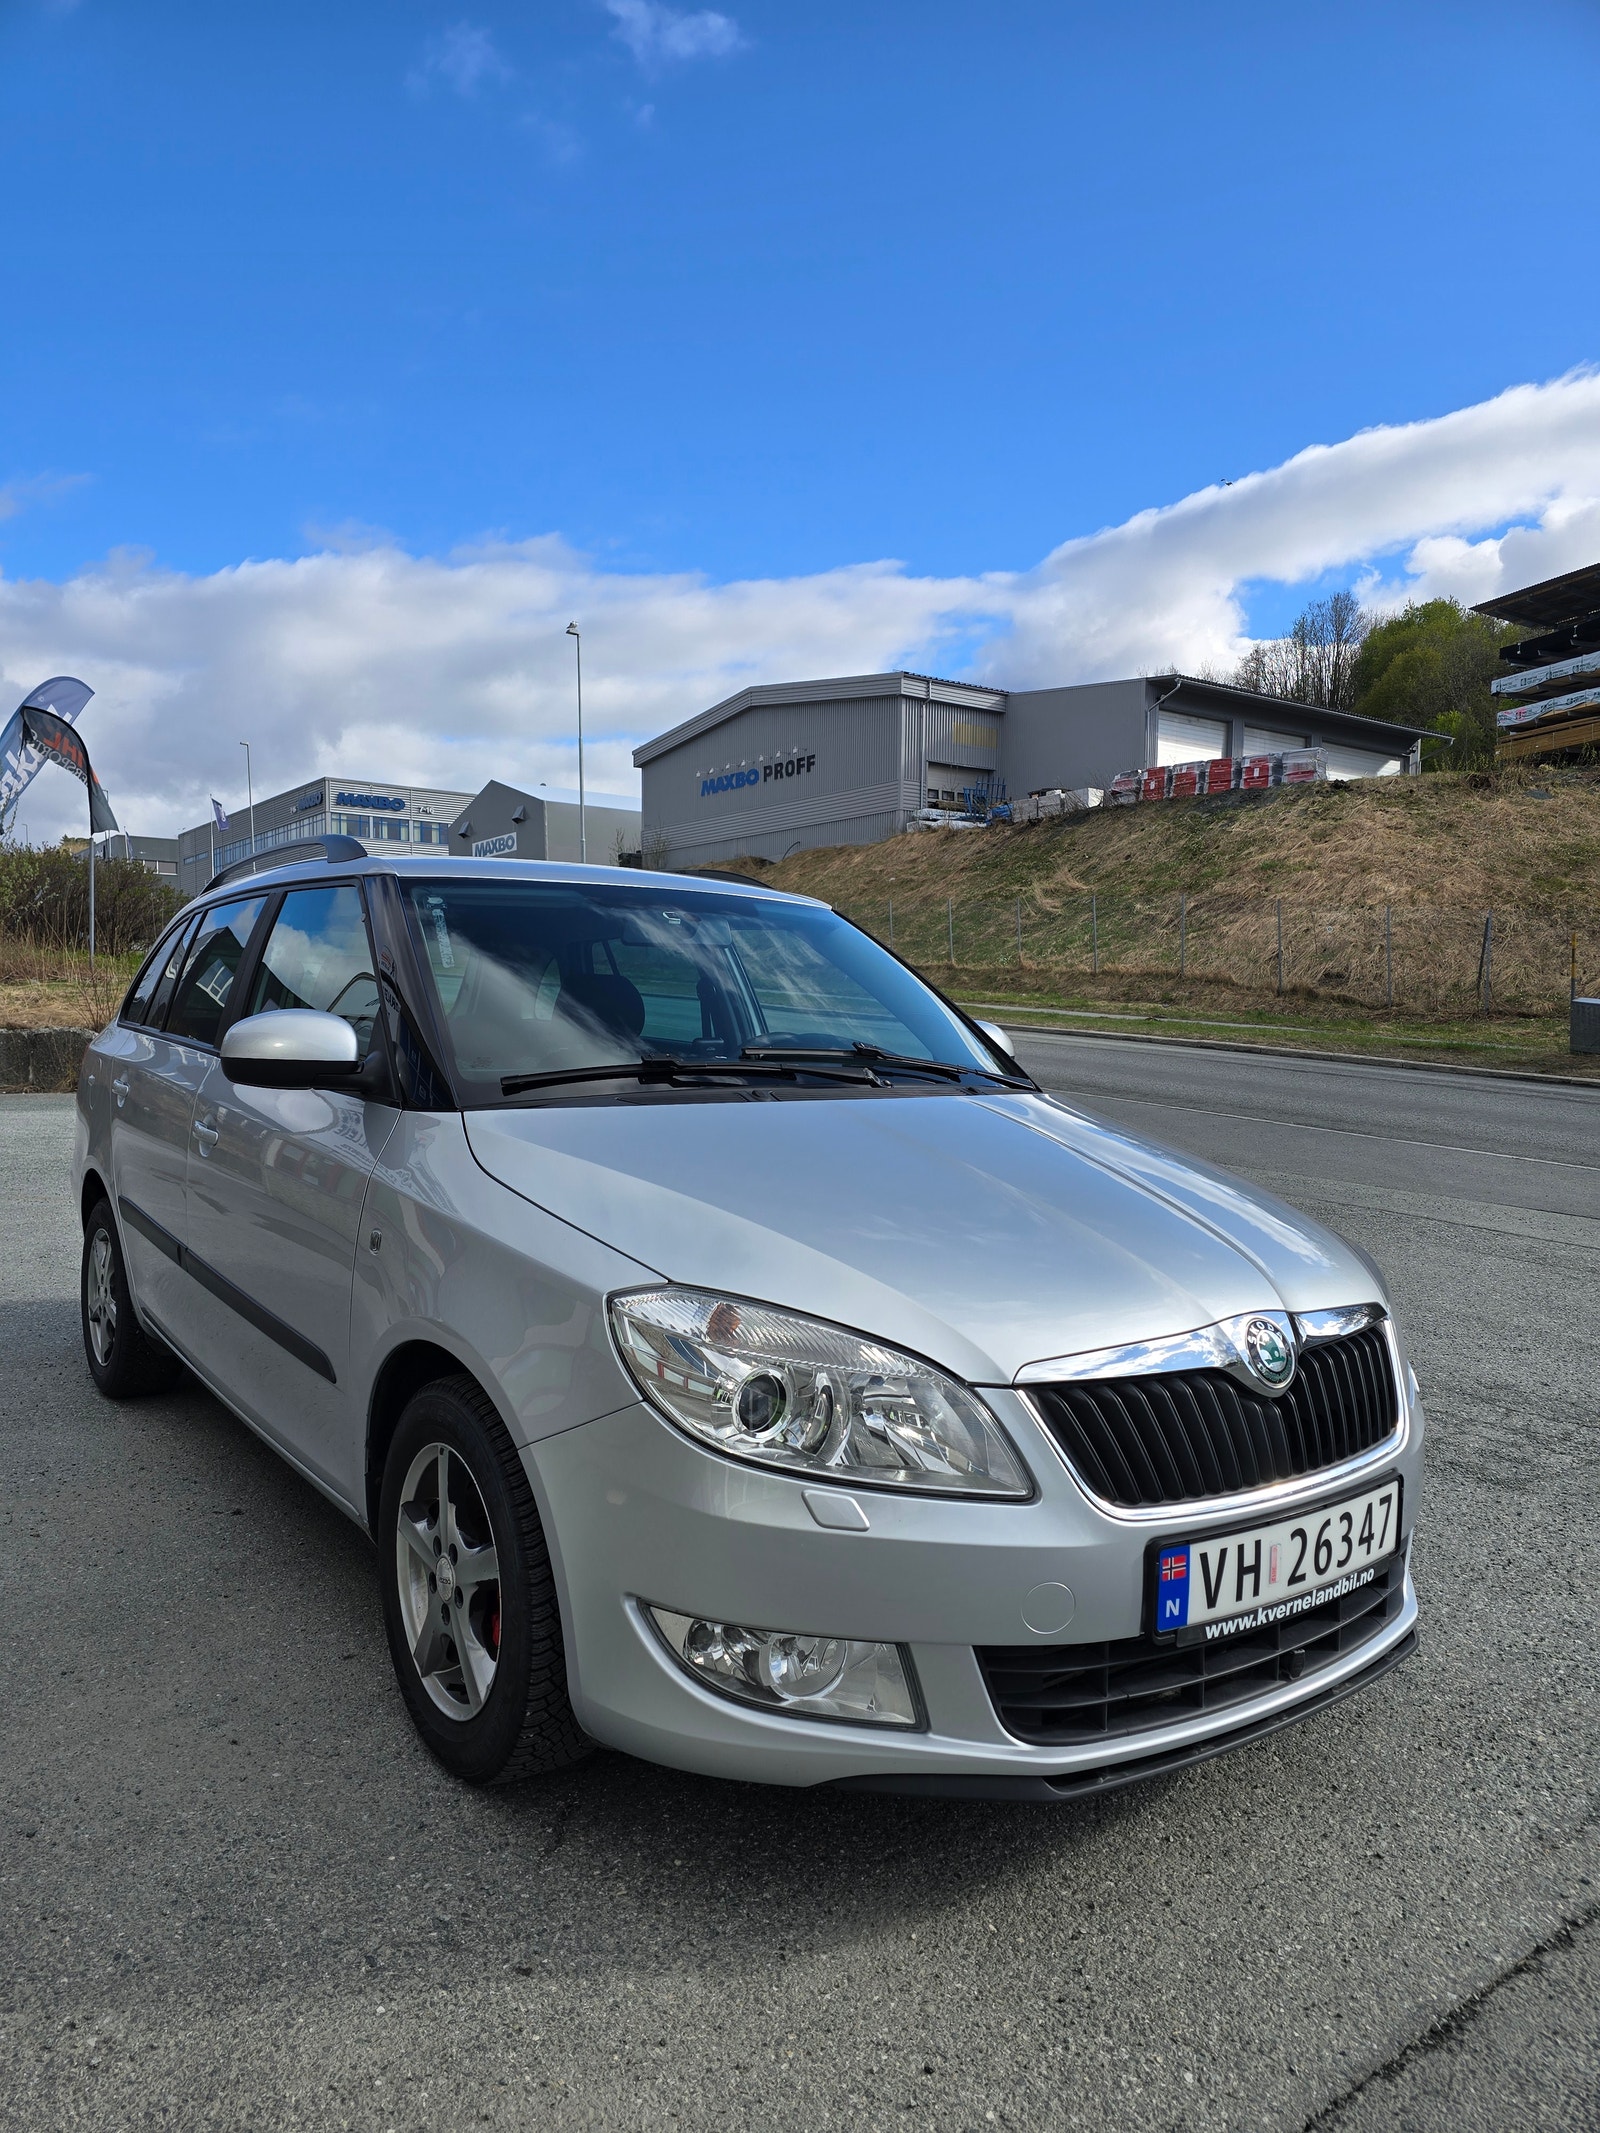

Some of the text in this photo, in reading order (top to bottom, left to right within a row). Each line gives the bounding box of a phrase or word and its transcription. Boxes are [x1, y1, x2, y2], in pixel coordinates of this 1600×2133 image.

[701, 754, 816, 797] MAXBO PROFF
[335, 792, 406, 812] MAXBO
[474, 834, 516, 858] MAXBO
[1199, 1539, 1262, 1610] VH
[1287, 1493, 1393, 1587] 26347
[1165, 1598, 1181, 1619] N
[1205, 1568, 1375, 1640] www.kvernelandbil.no
